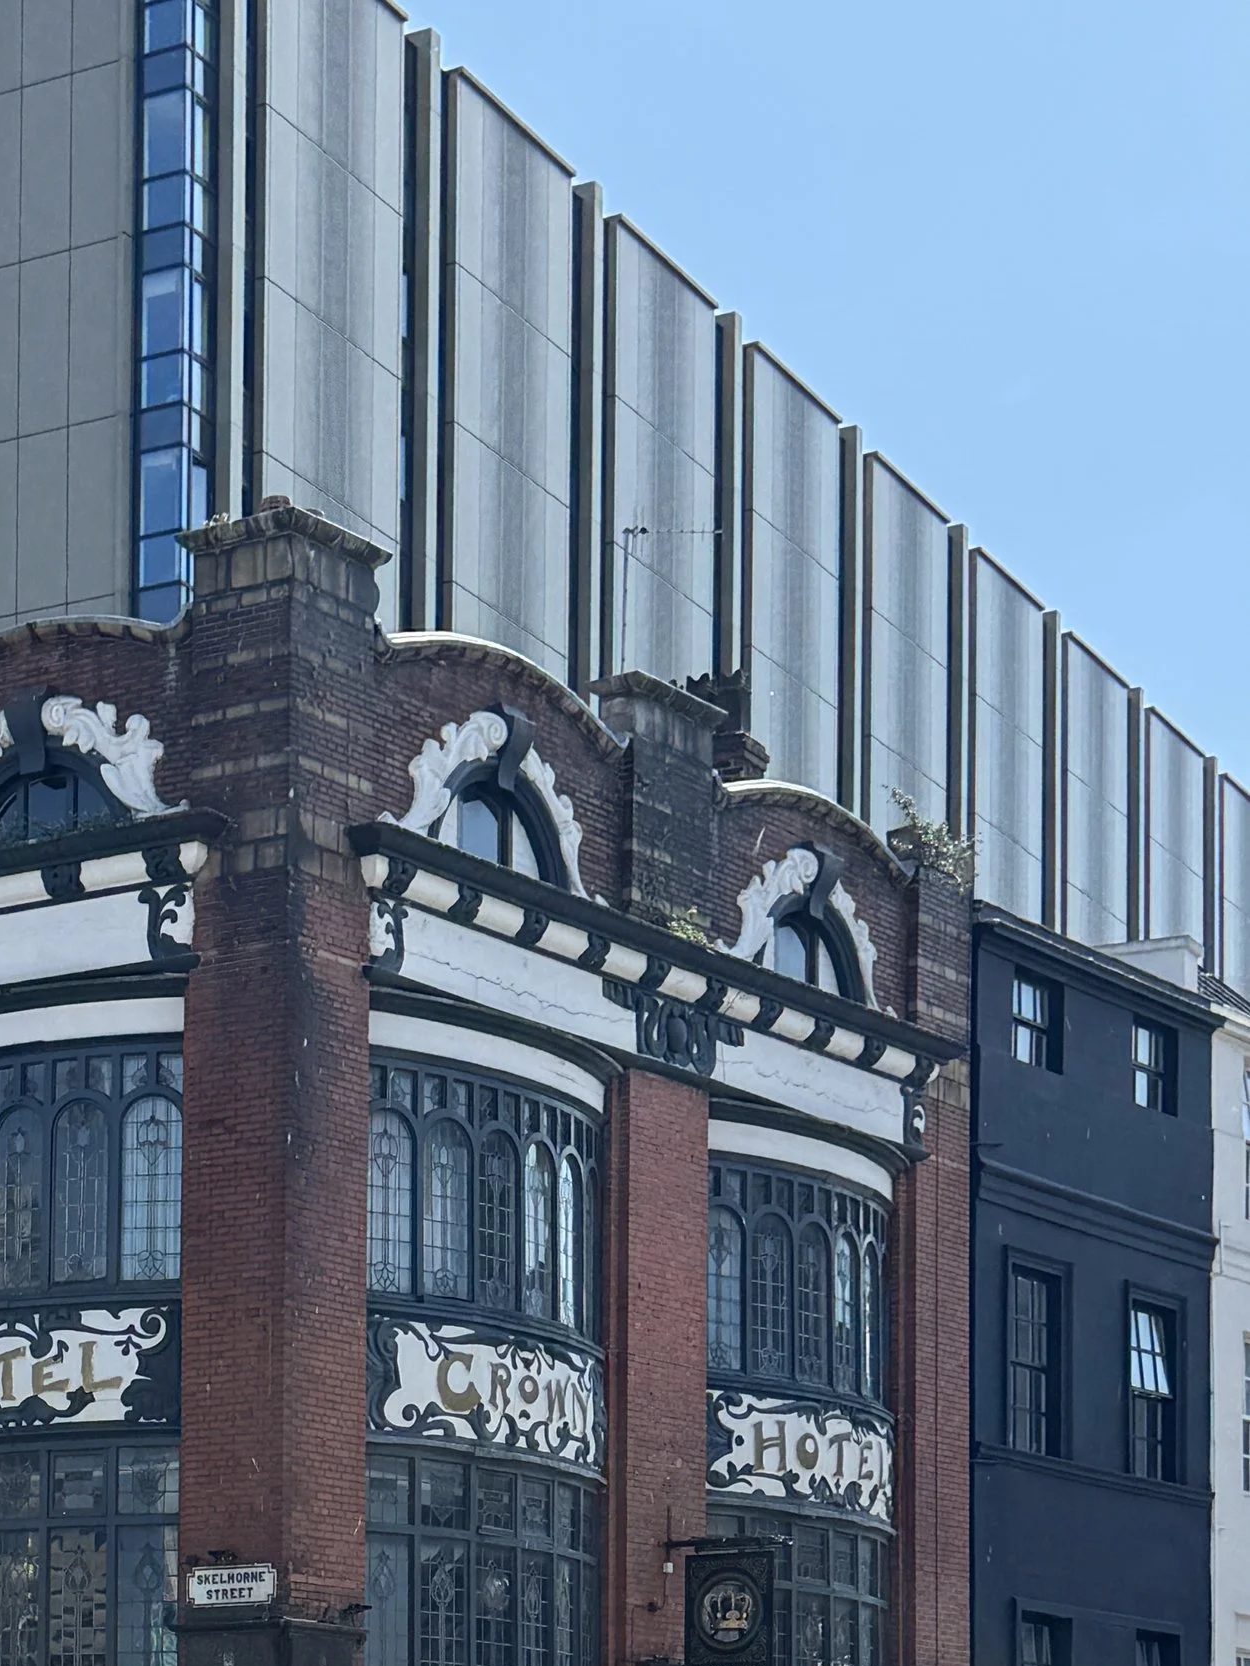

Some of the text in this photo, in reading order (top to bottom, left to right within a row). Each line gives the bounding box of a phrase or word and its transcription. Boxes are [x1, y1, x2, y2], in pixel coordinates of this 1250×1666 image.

[436, 1352, 590, 1434] CROWN
[753, 1420, 887, 1489] HOTEL
[196, 1571, 267, 1585] SKELHORNE
[206, 1587, 254, 1600] STREET
